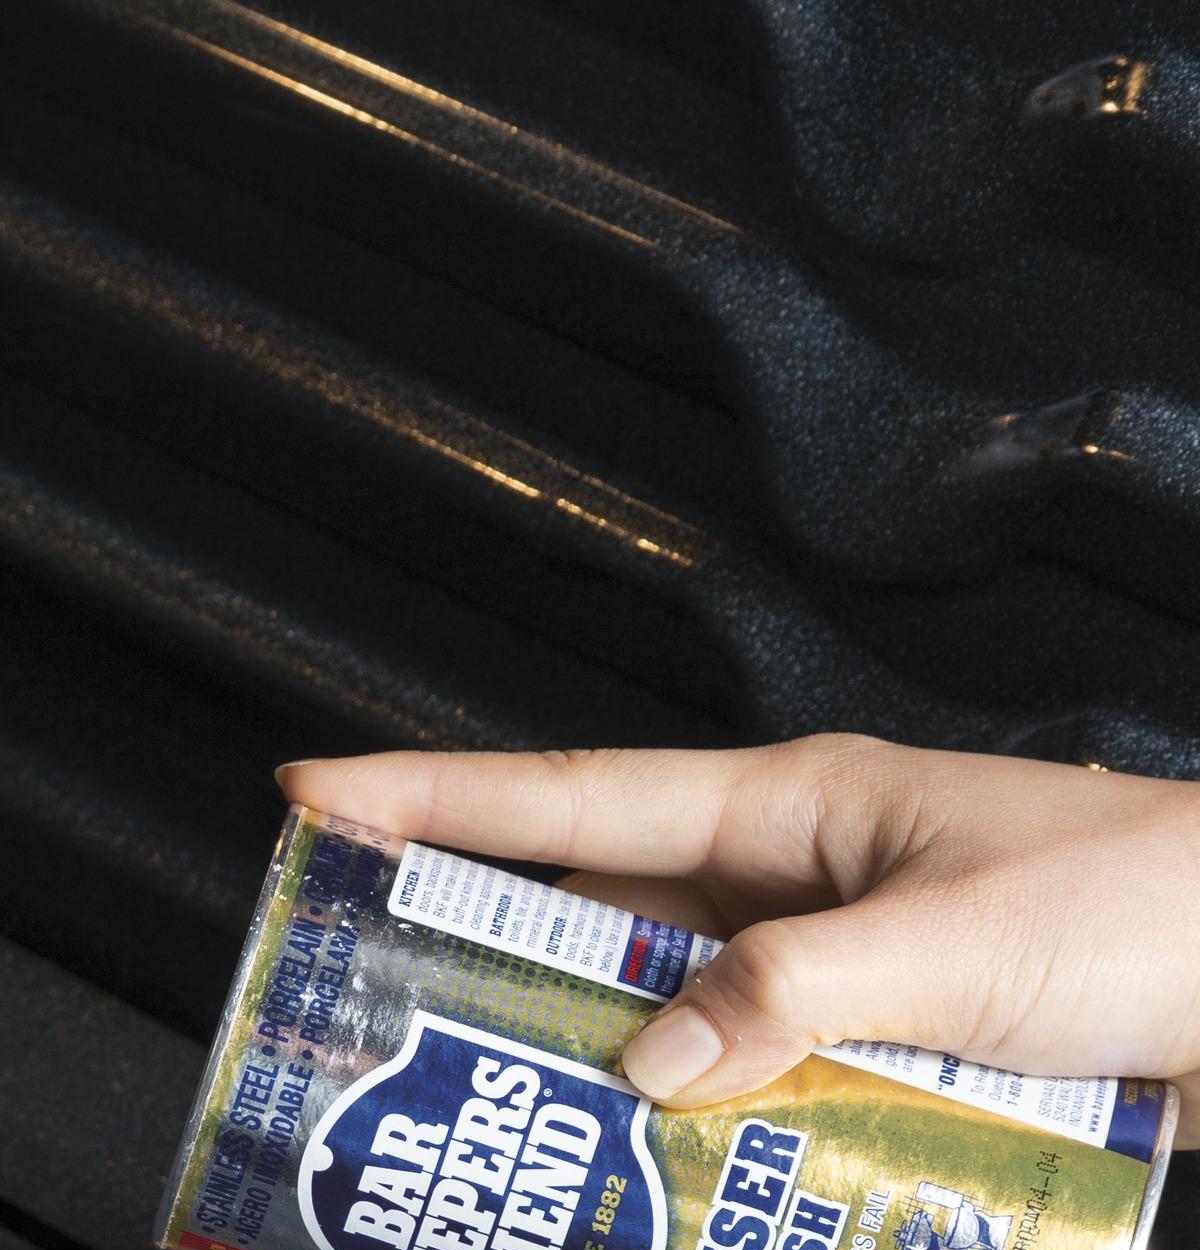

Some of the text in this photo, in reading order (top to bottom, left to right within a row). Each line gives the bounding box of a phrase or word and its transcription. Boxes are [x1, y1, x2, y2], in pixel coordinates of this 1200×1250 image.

[434, 900, 448, 918] BKF
[469, 898, 489, 931] cleaning
[527, 919, 543, 949] mineral
[587, 941, 598, 951] to
[581, 949, 595, 967] BKF
[651, 957, 662, 968] or
[297, 921, 361, 1045] PORCELANA
[644, 966, 659, 988] cloth
[662, 973, 675, 993] then
[194, 1127, 257, 1229] STAINLESS
[228, 1056, 280, 1133] STEEL
[256, 915, 327, 1043] PORCELAIN
[903, 1057, 914, 1073] are
[972, 1083, 985, 1095] To
[251, 1061, 315, 1186] INOXIDABLE
[1054, 1099, 1069, 1123] 5240
[343, 1113, 450, 1250] BAR
[233, 1185, 272, 1240] ACERO
[591, 1174, 629, 1237] 1882
[859, 1188, 891, 1233] FAIL
